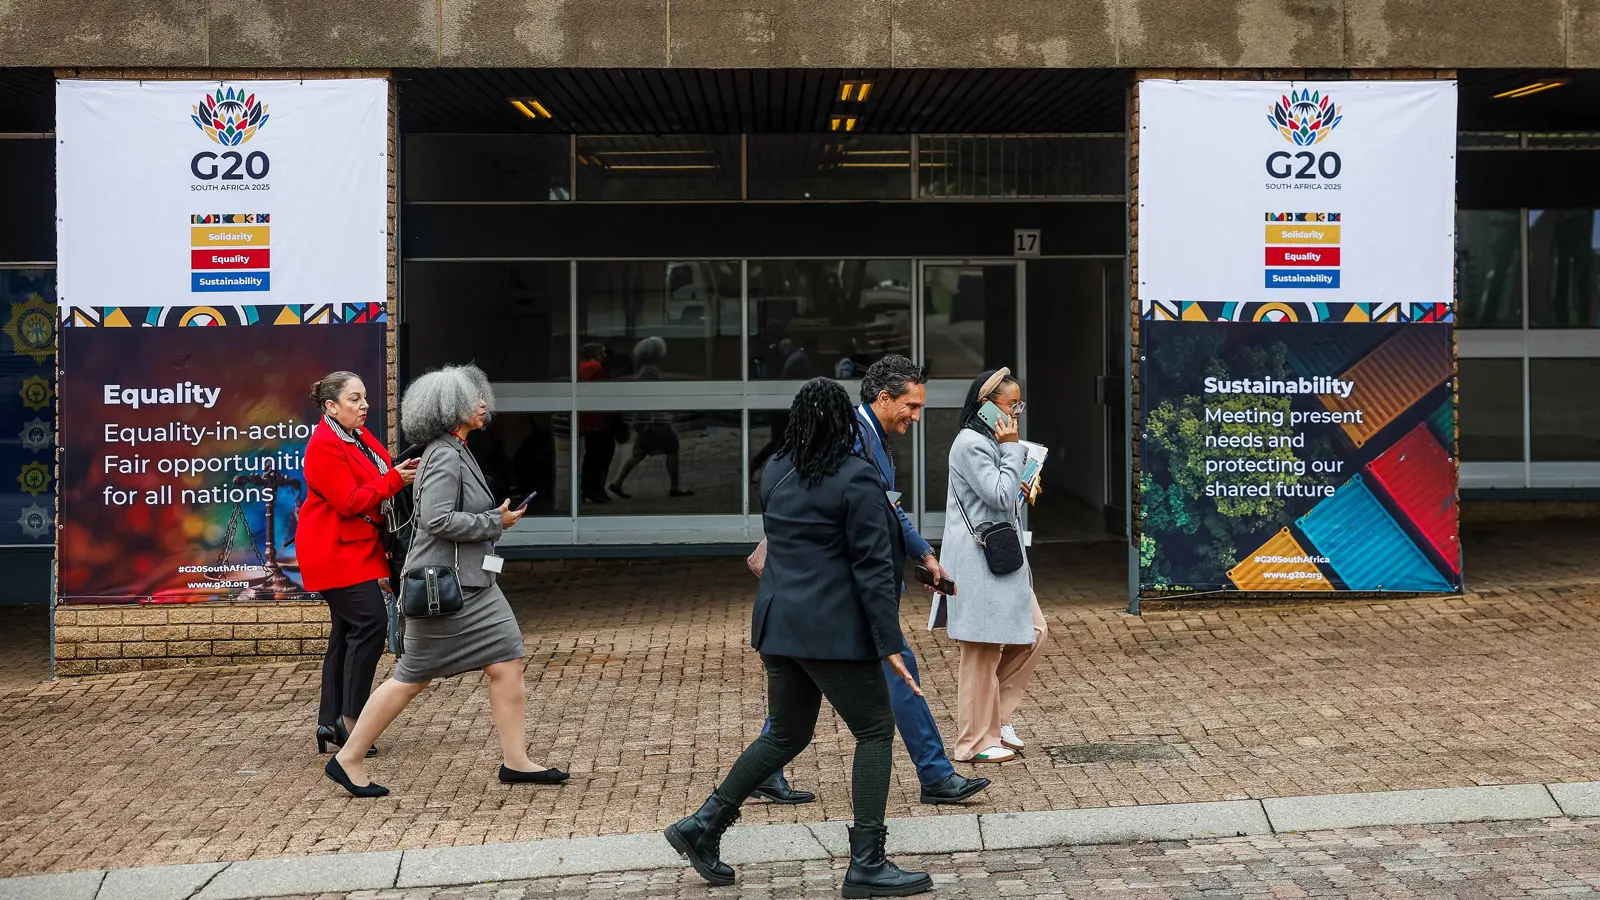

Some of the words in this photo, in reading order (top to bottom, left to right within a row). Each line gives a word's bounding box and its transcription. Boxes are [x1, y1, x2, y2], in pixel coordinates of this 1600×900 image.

[191, 151, 270, 180] G20
[1266, 151, 1342, 179] G20
[208, 232, 253, 242] Solidarity
[1017, 234, 1038, 251] 17
[1281, 230, 1325, 240] Solidarity
[211, 255, 250, 264] Equality
[1284, 252, 1321, 262] Equality
[199, 277, 263, 287] Sustainability
[1272, 274, 1333, 284] Sustainability
[103, 381, 221, 409] Equality
[1203, 376, 1354, 398] Sustainability
[1205, 407, 1284, 427] Meeting
[1290, 409, 1363, 427] present
[1205, 433, 1263, 448] needs
[1268, 432, 1305, 448] and
[104, 453, 150, 474] Fair
[157, 450, 306, 478] opportuniti
[1205, 456, 1306, 476] protecting
[1311, 460, 1344, 473] our
[103, 485, 138, 505] for
[145, 485, 172, 504] all
[181, 483, 274, 504] nations
[1205, 481, 1271, 497] shared
[1276, 481, 1336, 497] future
[1254, 555, 1331, 564] #G20SouthAfrica
[178, 564, 258, 573] #G20SouthAfrica
[1263, 571, 1323, 581] www.g20.org
[187, 580, 249, 590] www.g20.org
